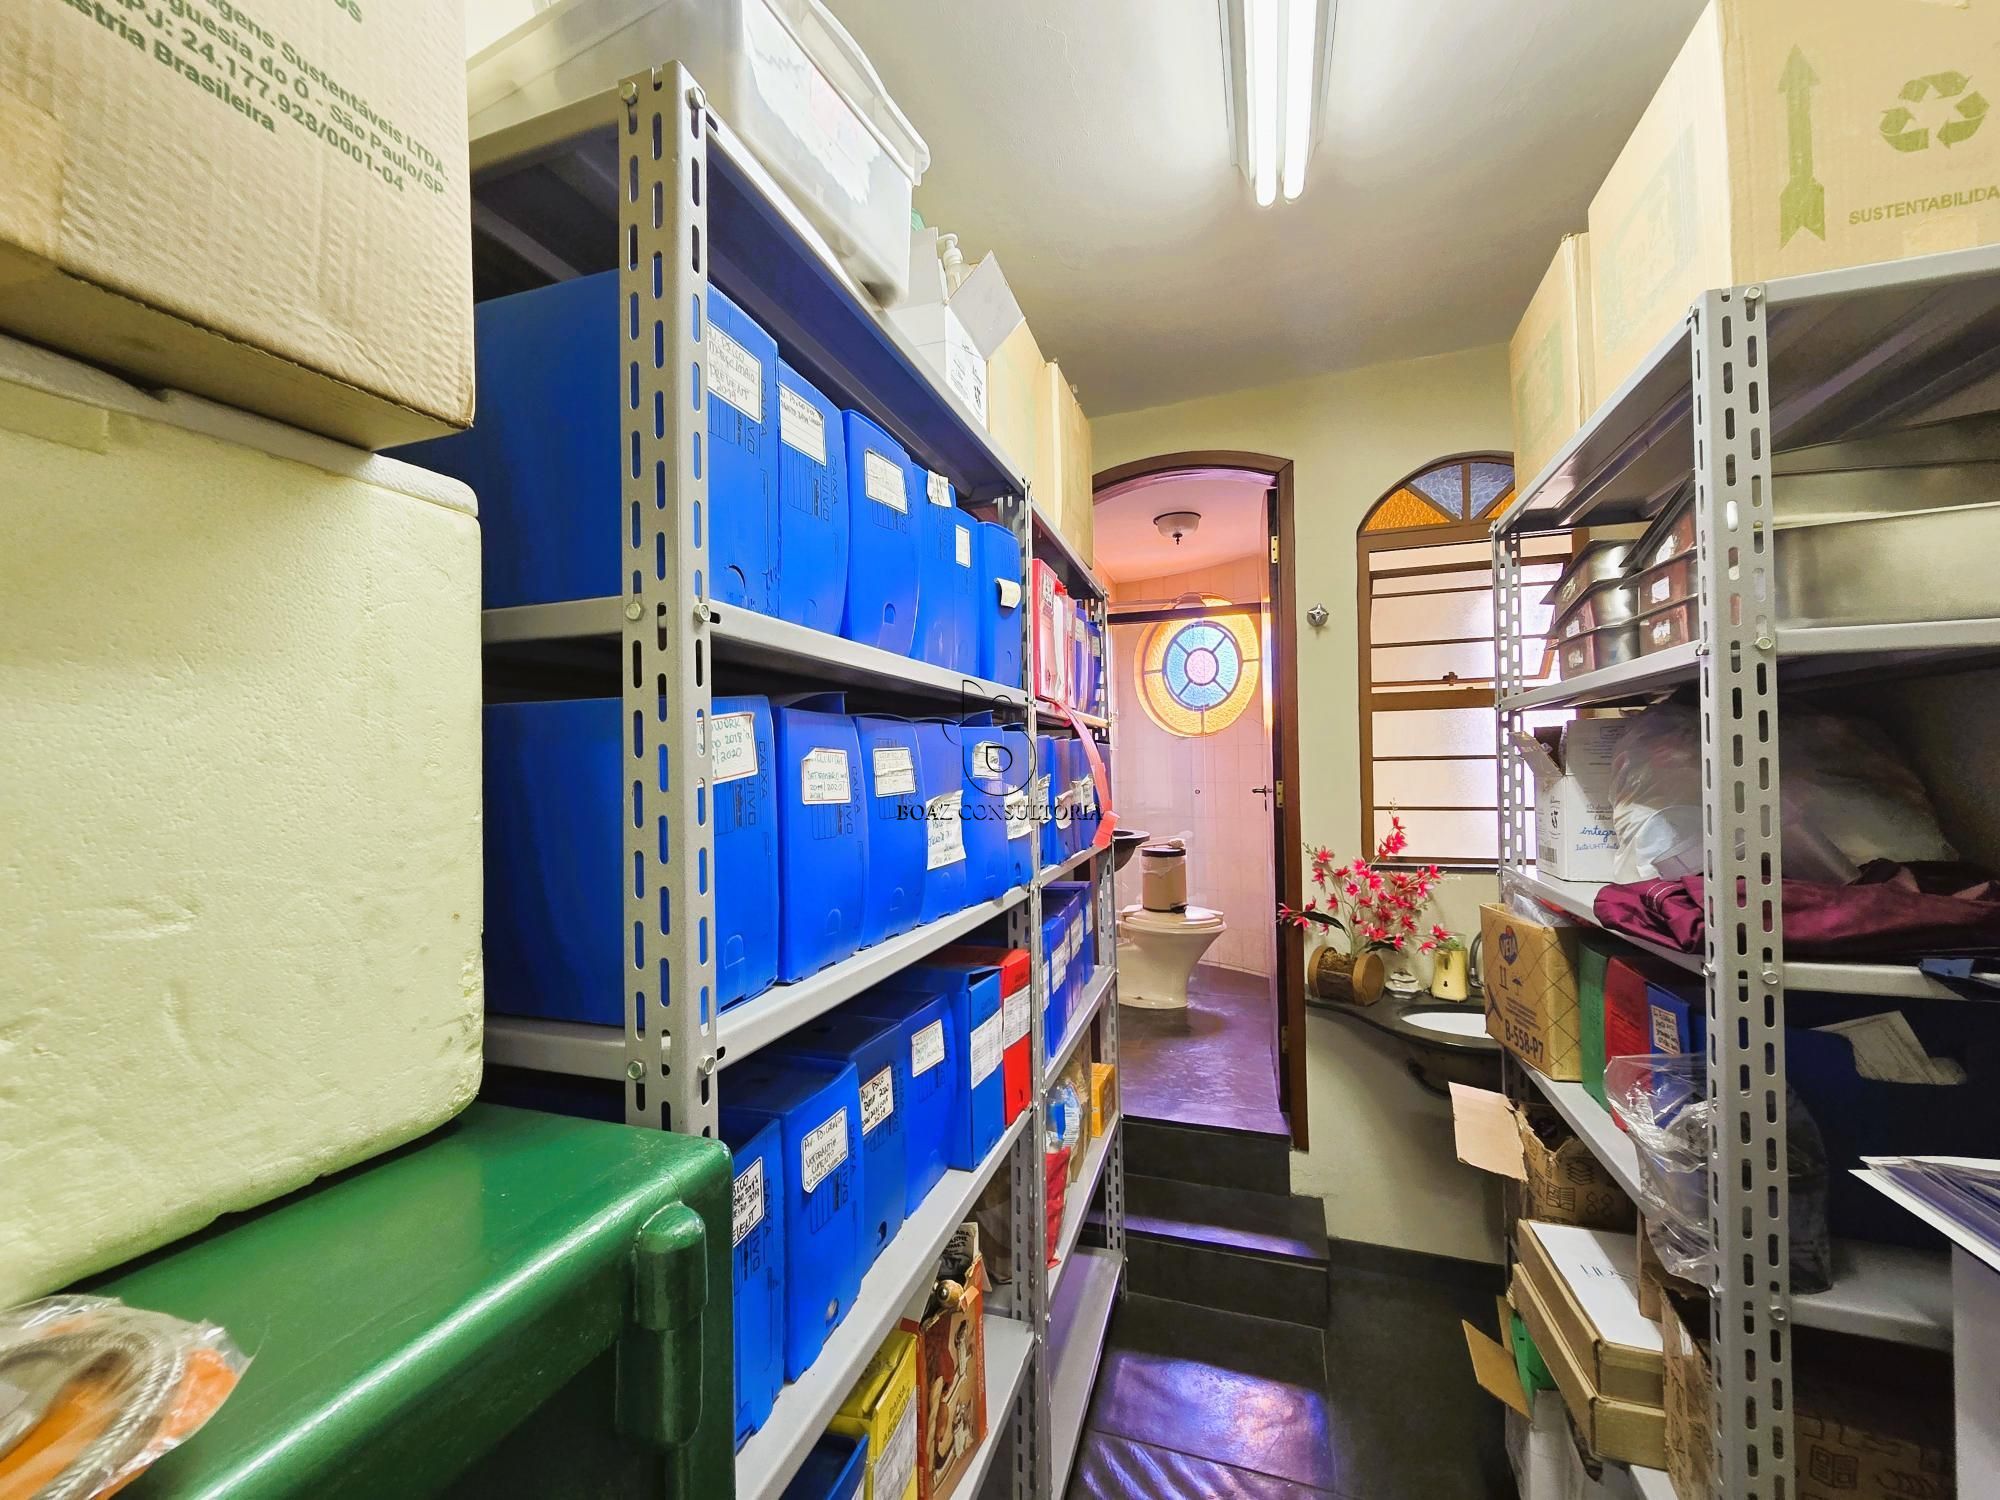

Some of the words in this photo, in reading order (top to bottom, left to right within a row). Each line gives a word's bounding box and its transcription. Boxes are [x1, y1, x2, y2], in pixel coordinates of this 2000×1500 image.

[154, 38, 276, 133] Brasileira
[165, 0, 253, 64] guesia
[259, 55, 288, 86] do
[330, 104, 366, 140] São
[370, 132, 445, 194] Paulo/SP
[281, 41, 403, 144] Sustentáveis
[406, 134, 449, 182] LTDA.
[1848, 185, 2000, 225] SUSTENTABILIDA
